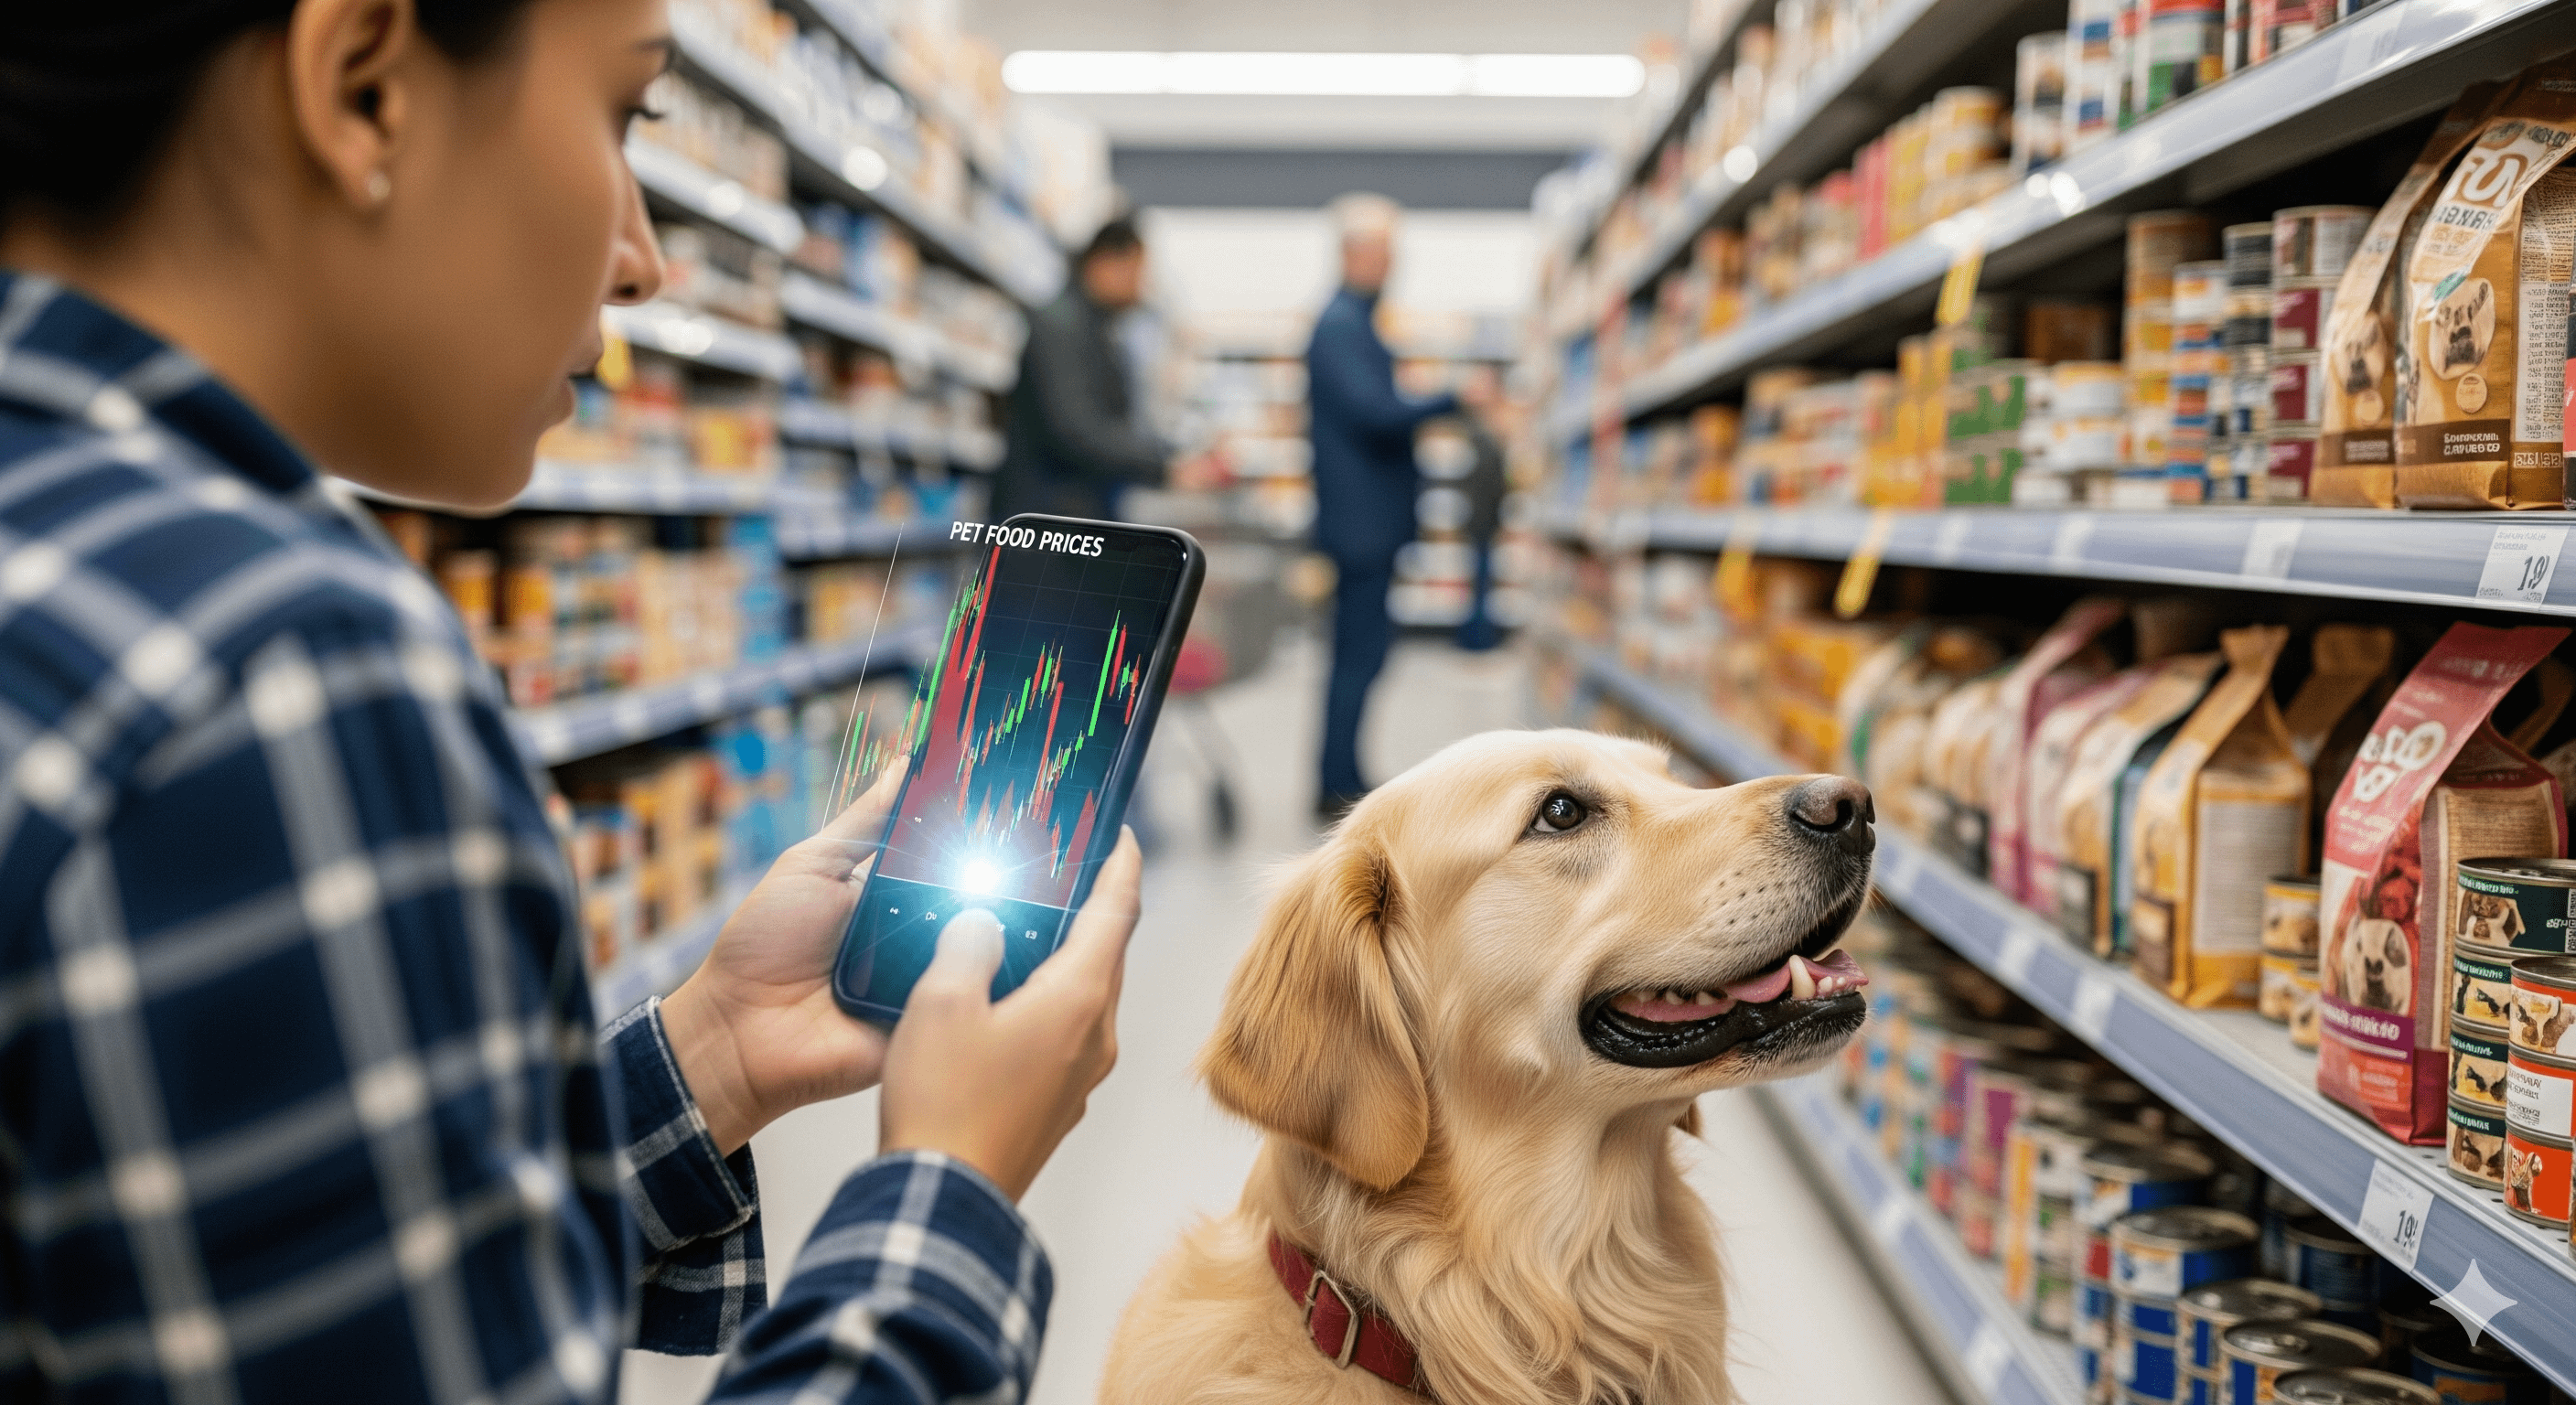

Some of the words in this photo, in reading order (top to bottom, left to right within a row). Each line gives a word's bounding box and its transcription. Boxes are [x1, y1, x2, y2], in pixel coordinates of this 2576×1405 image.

[950, 520, 984, 543] PET
[985, 525, 1036, 549] FOOD
[1038, 531, 1105, 557] PRICES
